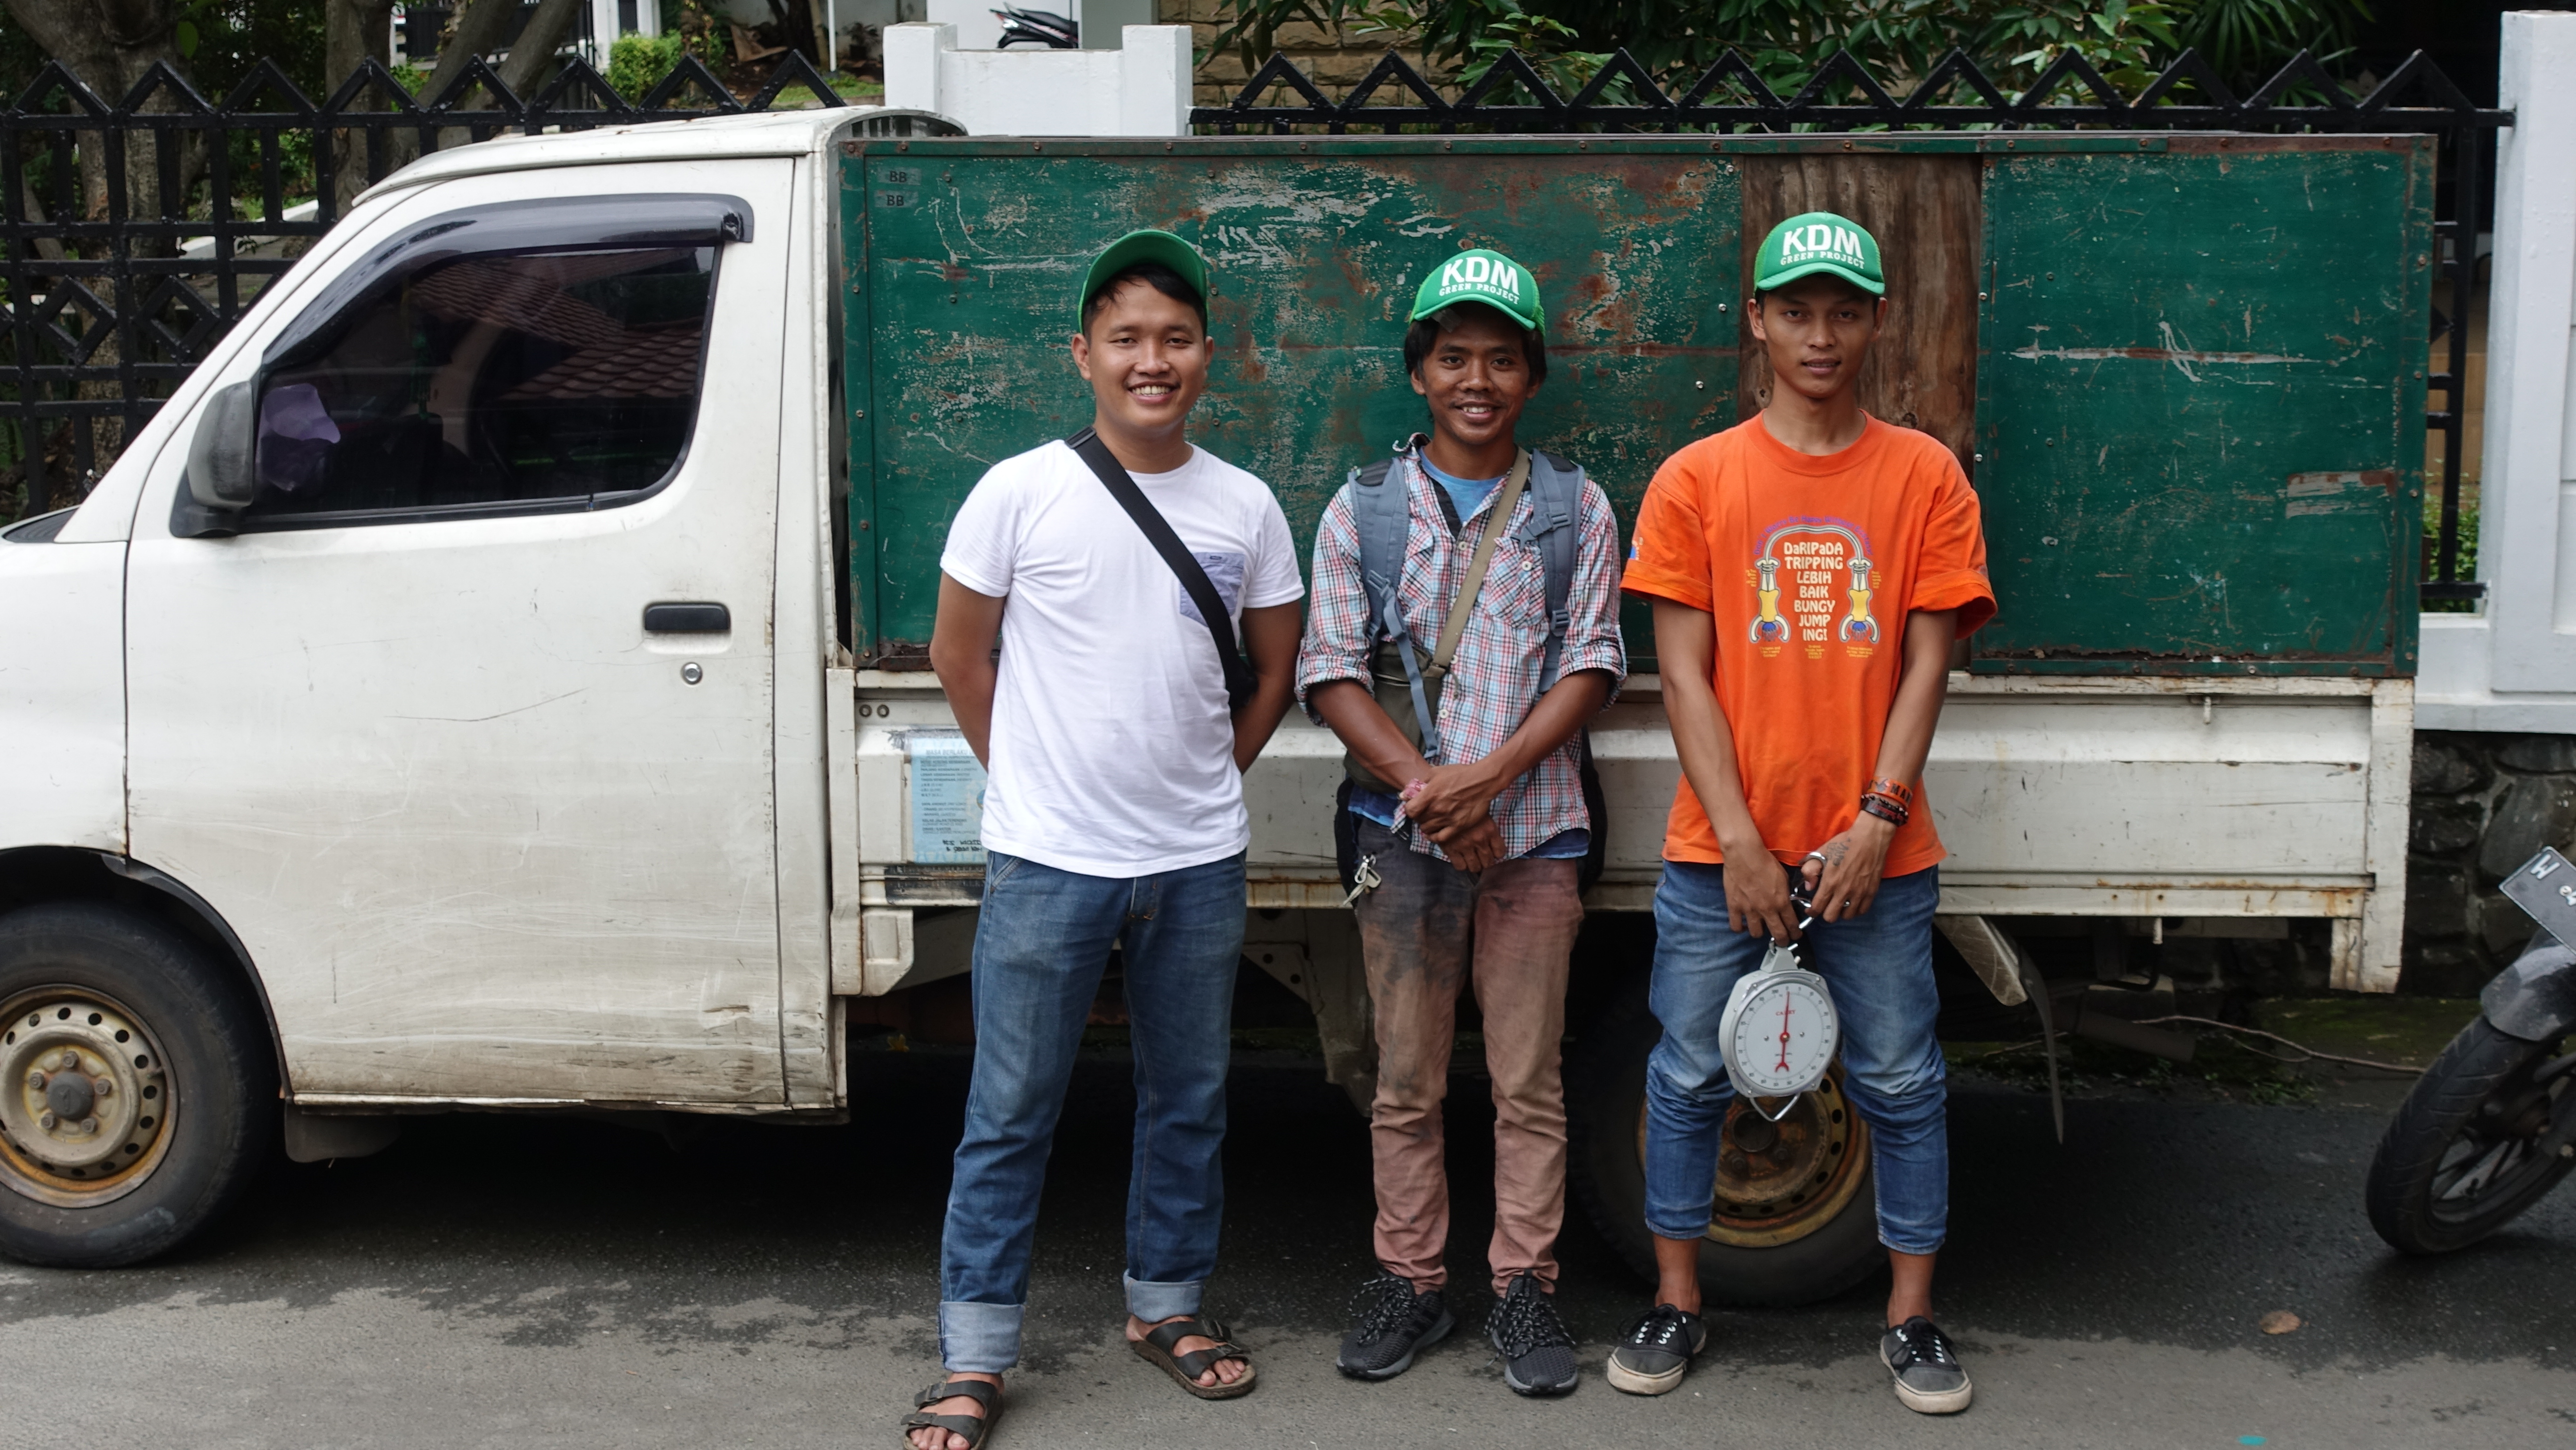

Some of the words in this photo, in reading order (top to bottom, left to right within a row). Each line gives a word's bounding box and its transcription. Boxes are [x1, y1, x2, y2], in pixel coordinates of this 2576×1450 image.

[889, 171, 907, 183] BB
[886, 194, 904, 206] BB
[1783, 224, 1864, 259] KDM
[1780, 251, 1814, 266] GREEN
[1820, 251, 1865, 269] PROJECT
[1441, 257, 1520, 295] KDM
[1439, 283, 1472, 296] GREEN
[1476, 283, 1520, 305] PROJECT
[1784, 556, 1843, 570] TRIPPING
[1796, 571, 1832, 584] LEBIH
[1799, 586, 1829, 598] BAIK
[1794, 600, 1835, 612] BUNGY
[1799, 614, 1831, 627] JUMP
[1803, 628, 1828, 641] ING!
[2530, 854, 2560, 879] W
